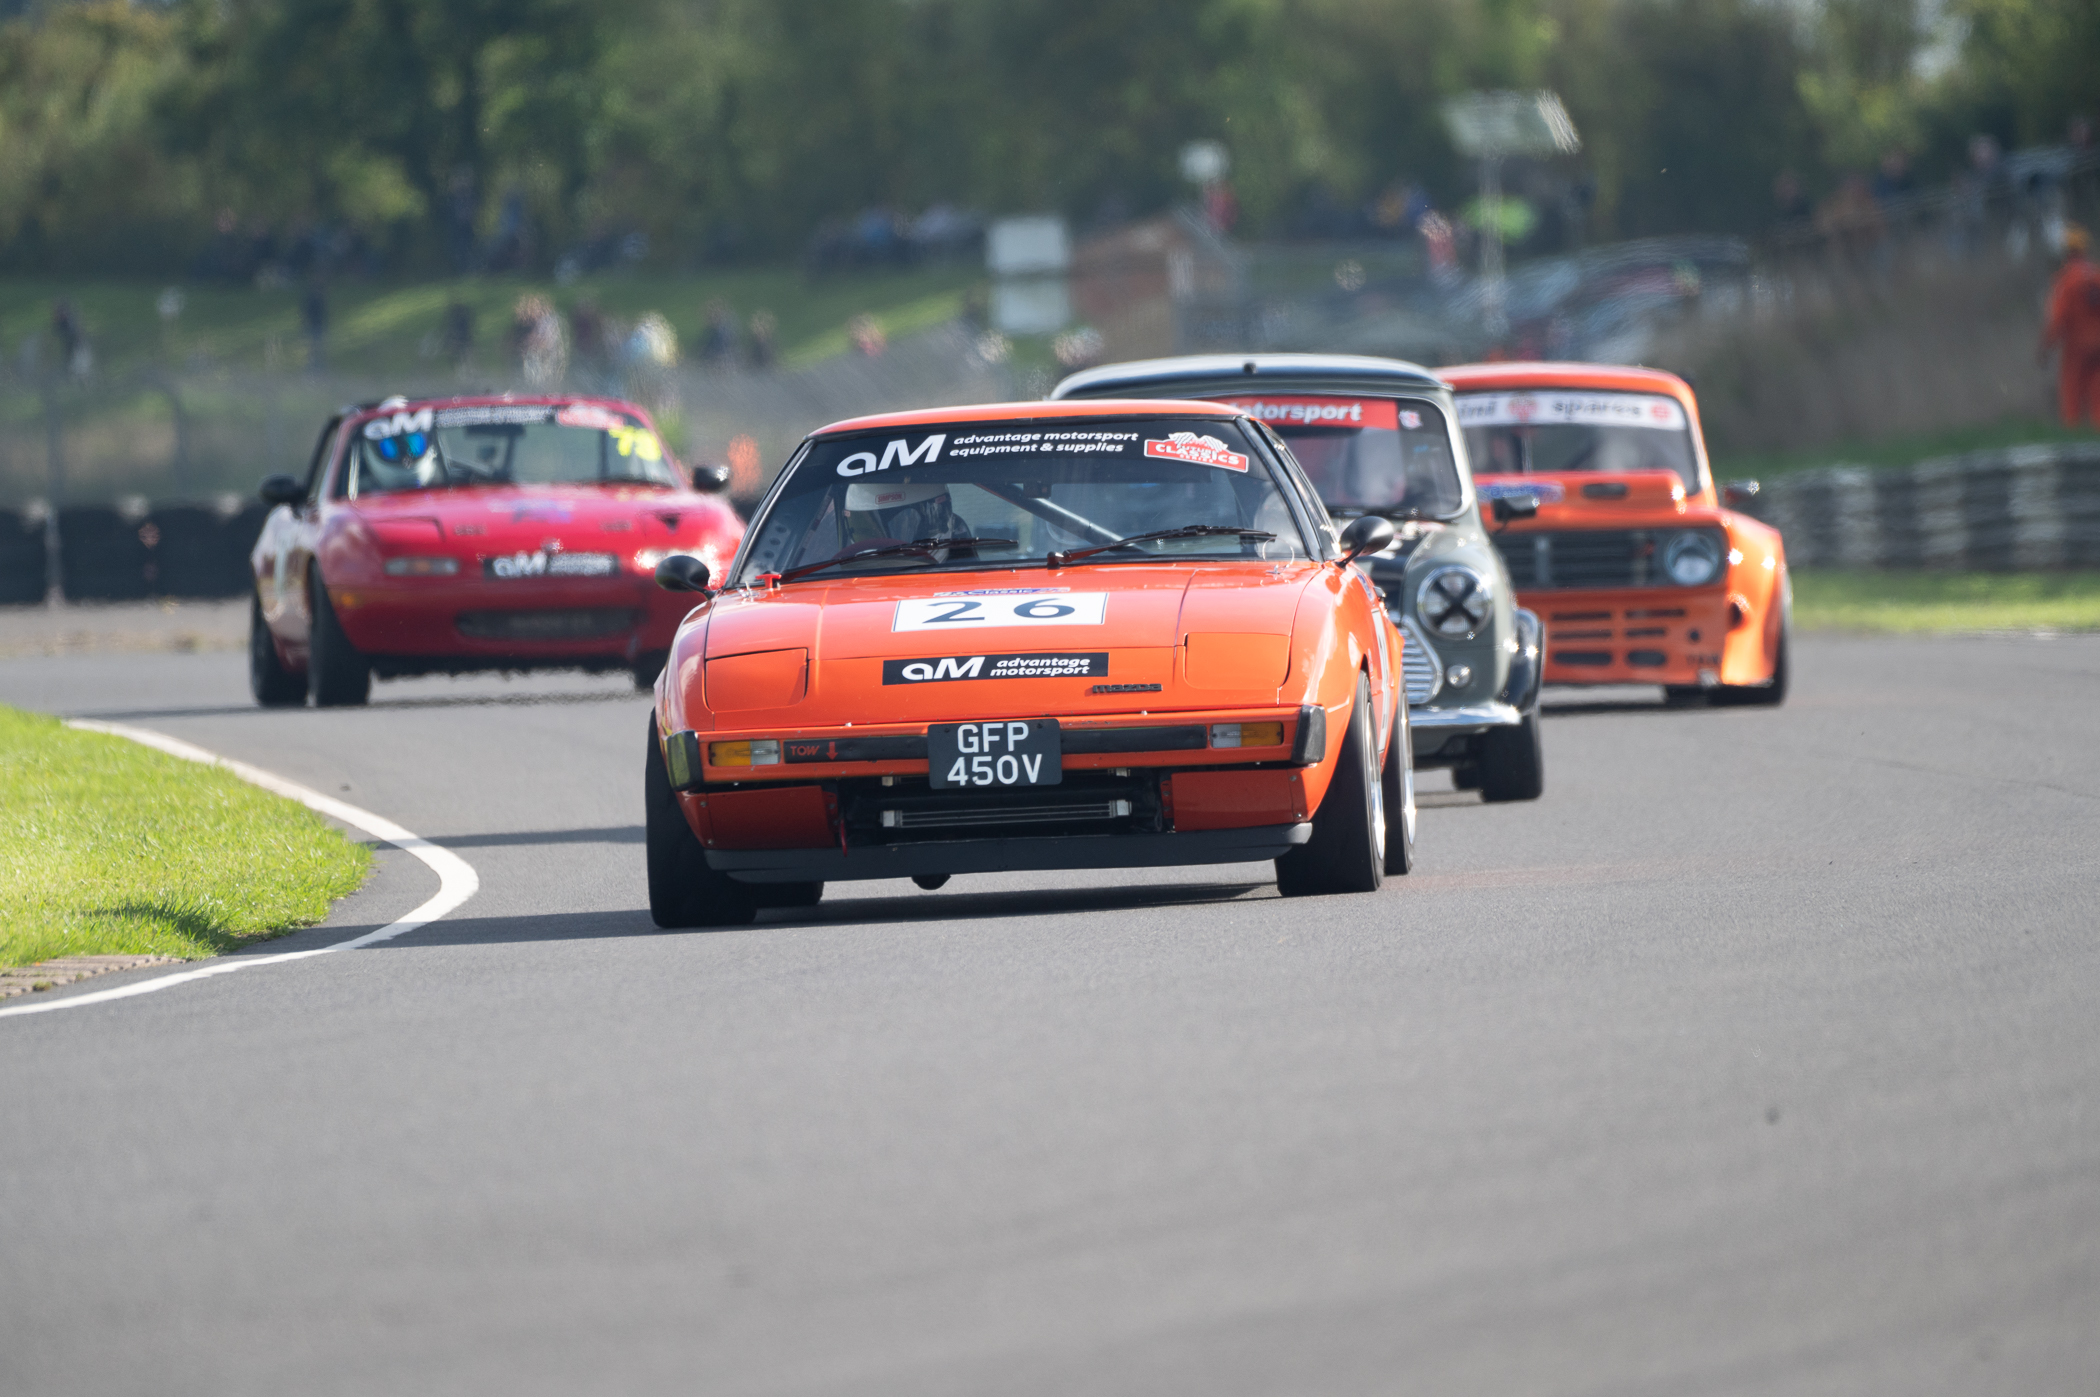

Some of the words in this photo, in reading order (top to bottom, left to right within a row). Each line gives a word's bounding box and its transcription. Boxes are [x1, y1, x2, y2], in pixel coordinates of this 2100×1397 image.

[1229, 402, 1363, 425] otorsport
[953, 432, 1041, 446] advantage
[1043, 431, 1139, 442] motorsport
[836, 433, 947, 477] aM
[949, 443, 1038, 458] equipment
[1039, 443, 1054, 453] &
[1055, 442, 1124, 454] supplies
[1155, 443, 1240, 465] CLASSICS
[902, 656, 986, 680] aM
[989, 665, 1090, 677] motorsport
[992, 657, 1091, 668] advantage
[1092, 683, 1162, 693] mazda
[957, 722, 1029, 753] GFP
[790, 745, 820, 756] TOW
[947, 753, 1043, 786] 450V
